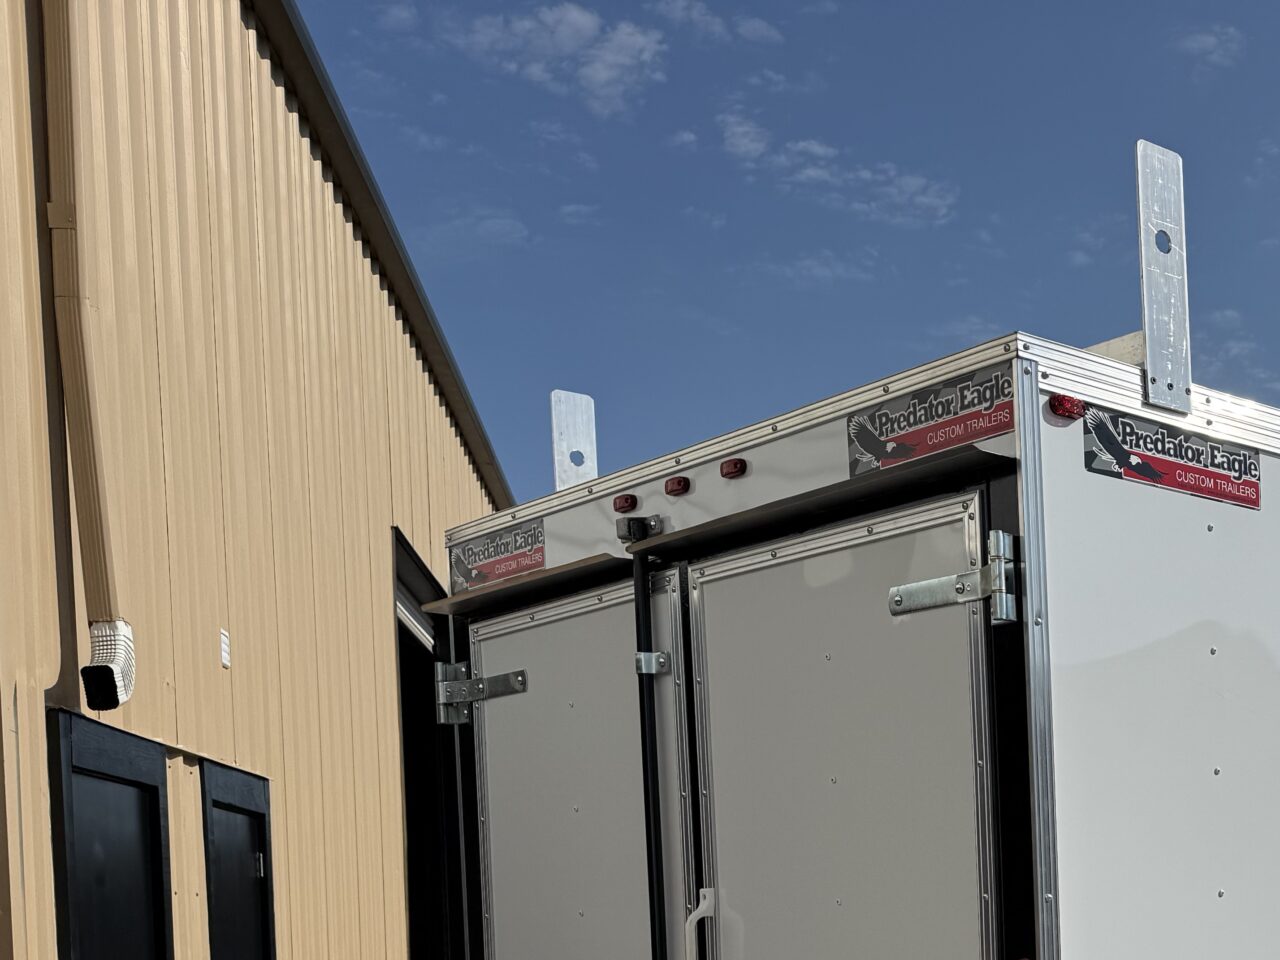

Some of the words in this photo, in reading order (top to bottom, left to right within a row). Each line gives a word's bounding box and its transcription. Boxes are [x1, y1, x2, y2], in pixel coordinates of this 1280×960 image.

[876, 394, 957, 440] Predator
[957, 372, 1014, 414] Eagle
[927, 424, 964, 445] CUSTOM
[967, 409, 1010, 433] TRAILERS
[1119, 418, 1204, 467] Predator
[1207, 441, 1260, 482] Eagle
[1175, 470, 1214, 489] CUSTOM
[1216, 479, 1256, 499] TRAILERS
[465, 537, 511, 567] Predator
[512, 524, 545, 554] Eagle
[495, 561, 517, 574] CUSTOM
[518, 552, 543, 567] TRAILERS
